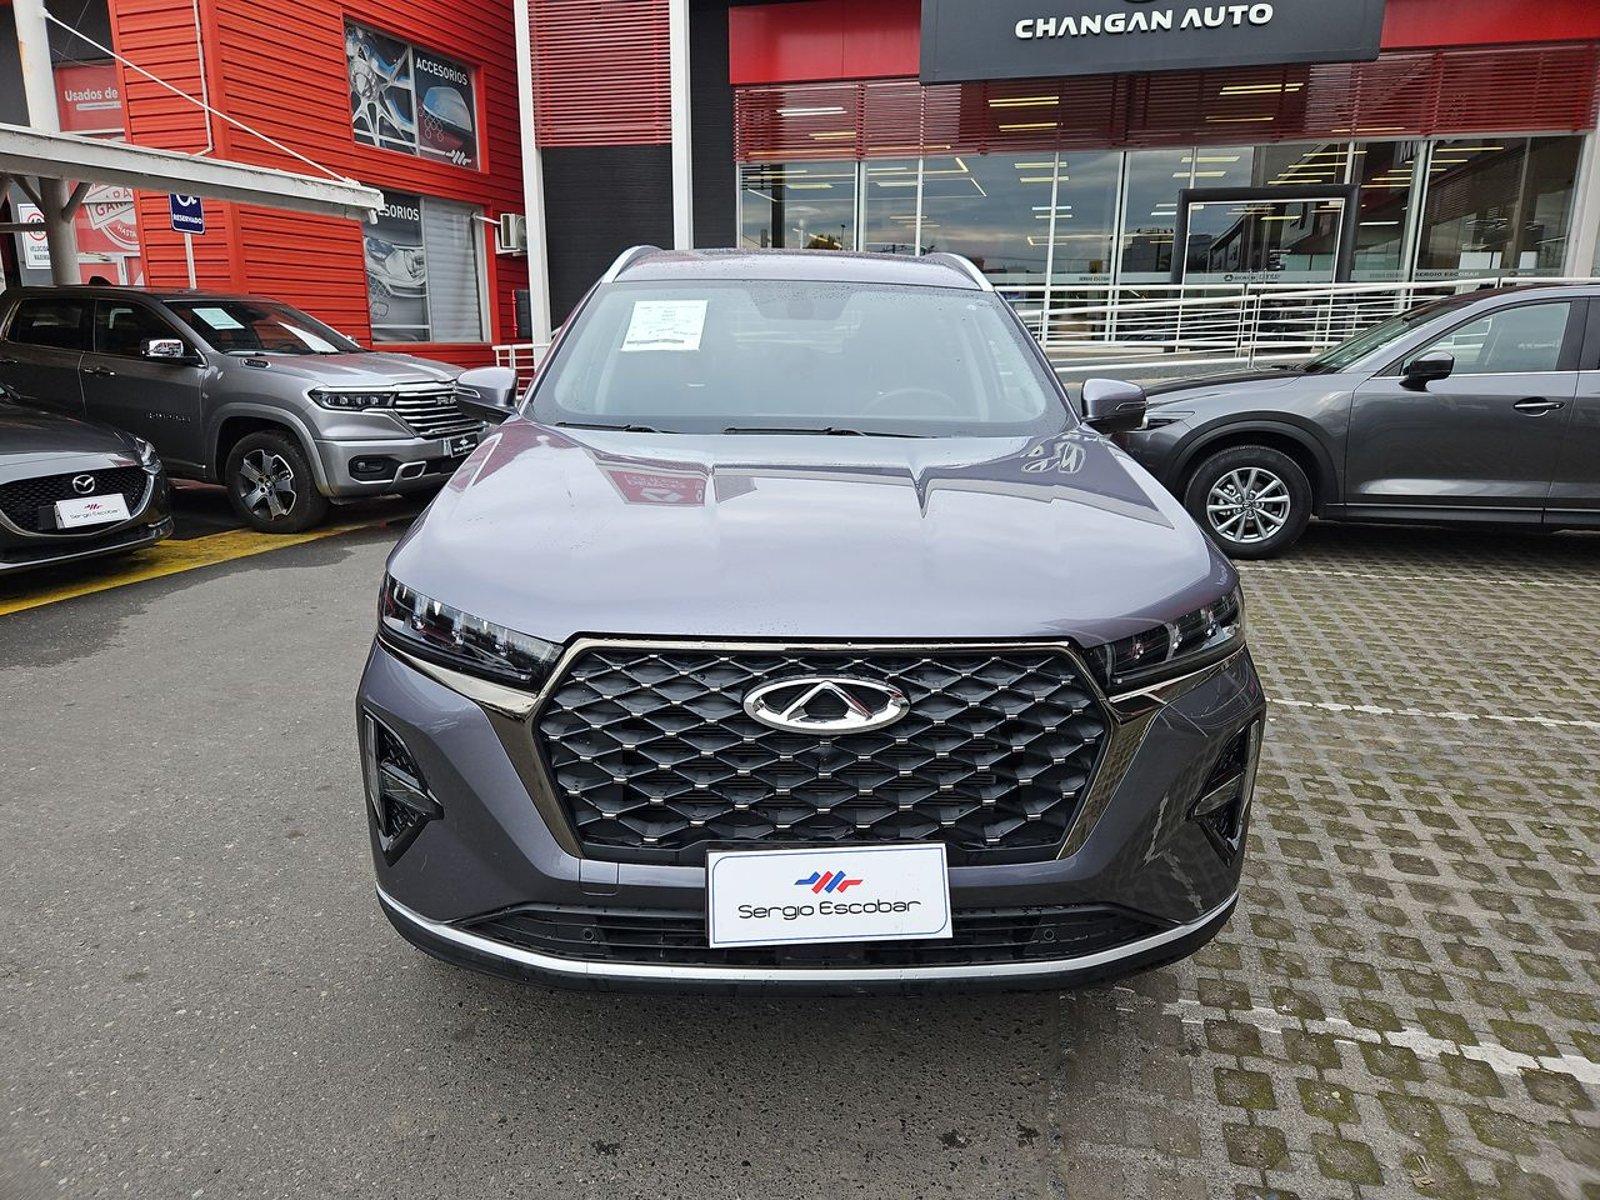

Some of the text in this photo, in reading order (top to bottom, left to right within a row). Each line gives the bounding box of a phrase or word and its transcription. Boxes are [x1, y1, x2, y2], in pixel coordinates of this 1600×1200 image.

[1015, 3, 1274, 39] CHANGAN AUTO
[415, 57, 469, 86] ACCESORIOS
[64, 87, 118, 102] Usados de
[173, 213, 203, 224] RESERVADO
[738, 898, 922, 921] Sergio Escobar
